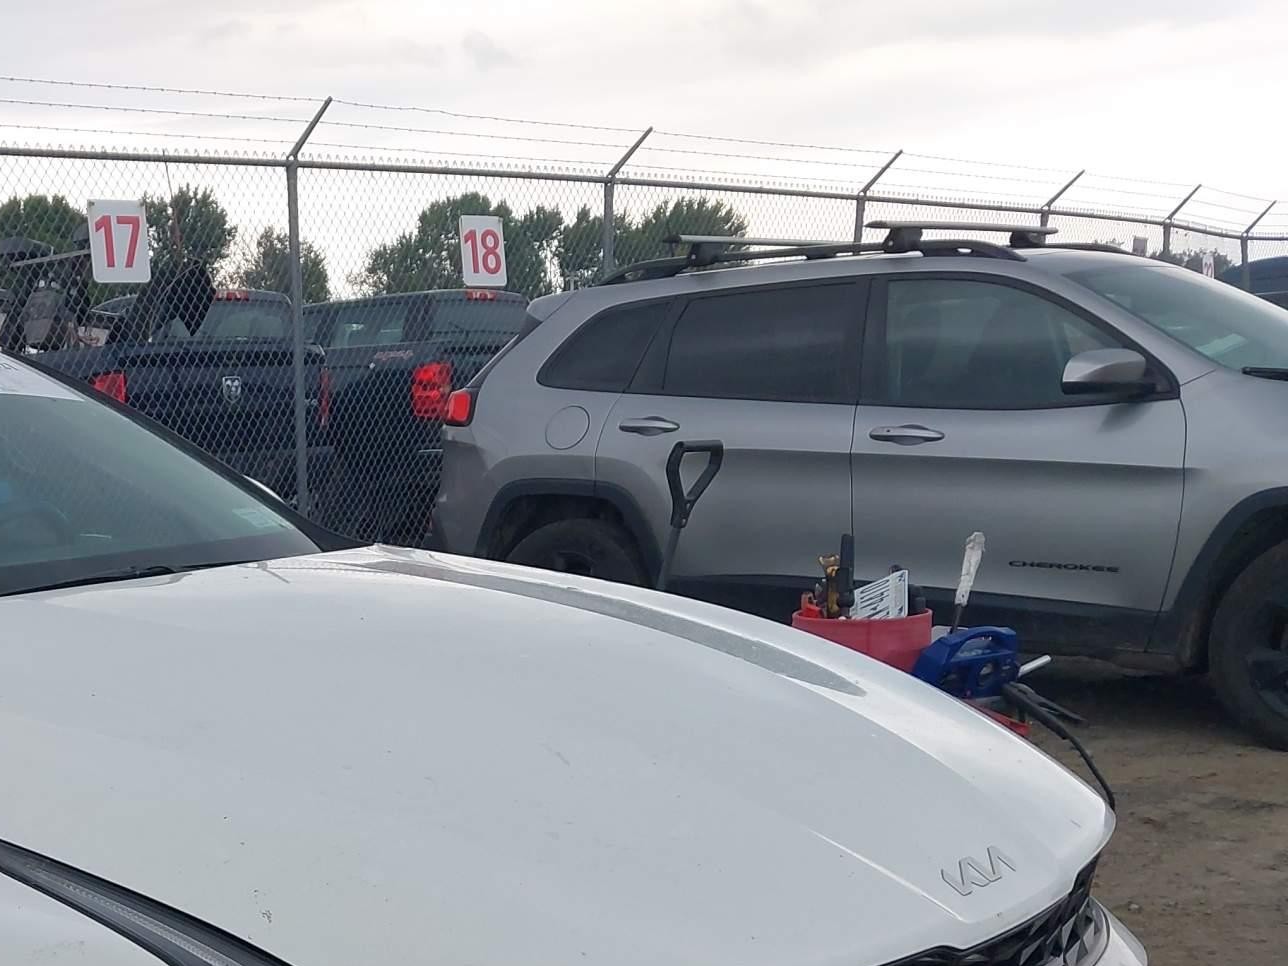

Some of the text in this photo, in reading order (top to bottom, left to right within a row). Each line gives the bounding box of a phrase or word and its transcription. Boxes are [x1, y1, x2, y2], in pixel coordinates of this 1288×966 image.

[94, 215, 140, 268] 17
[464, 229, 502, 275] 18
[1008, 560, 1120, 573] CHEROKEE
[940, 846, 1016, 897] KIA
